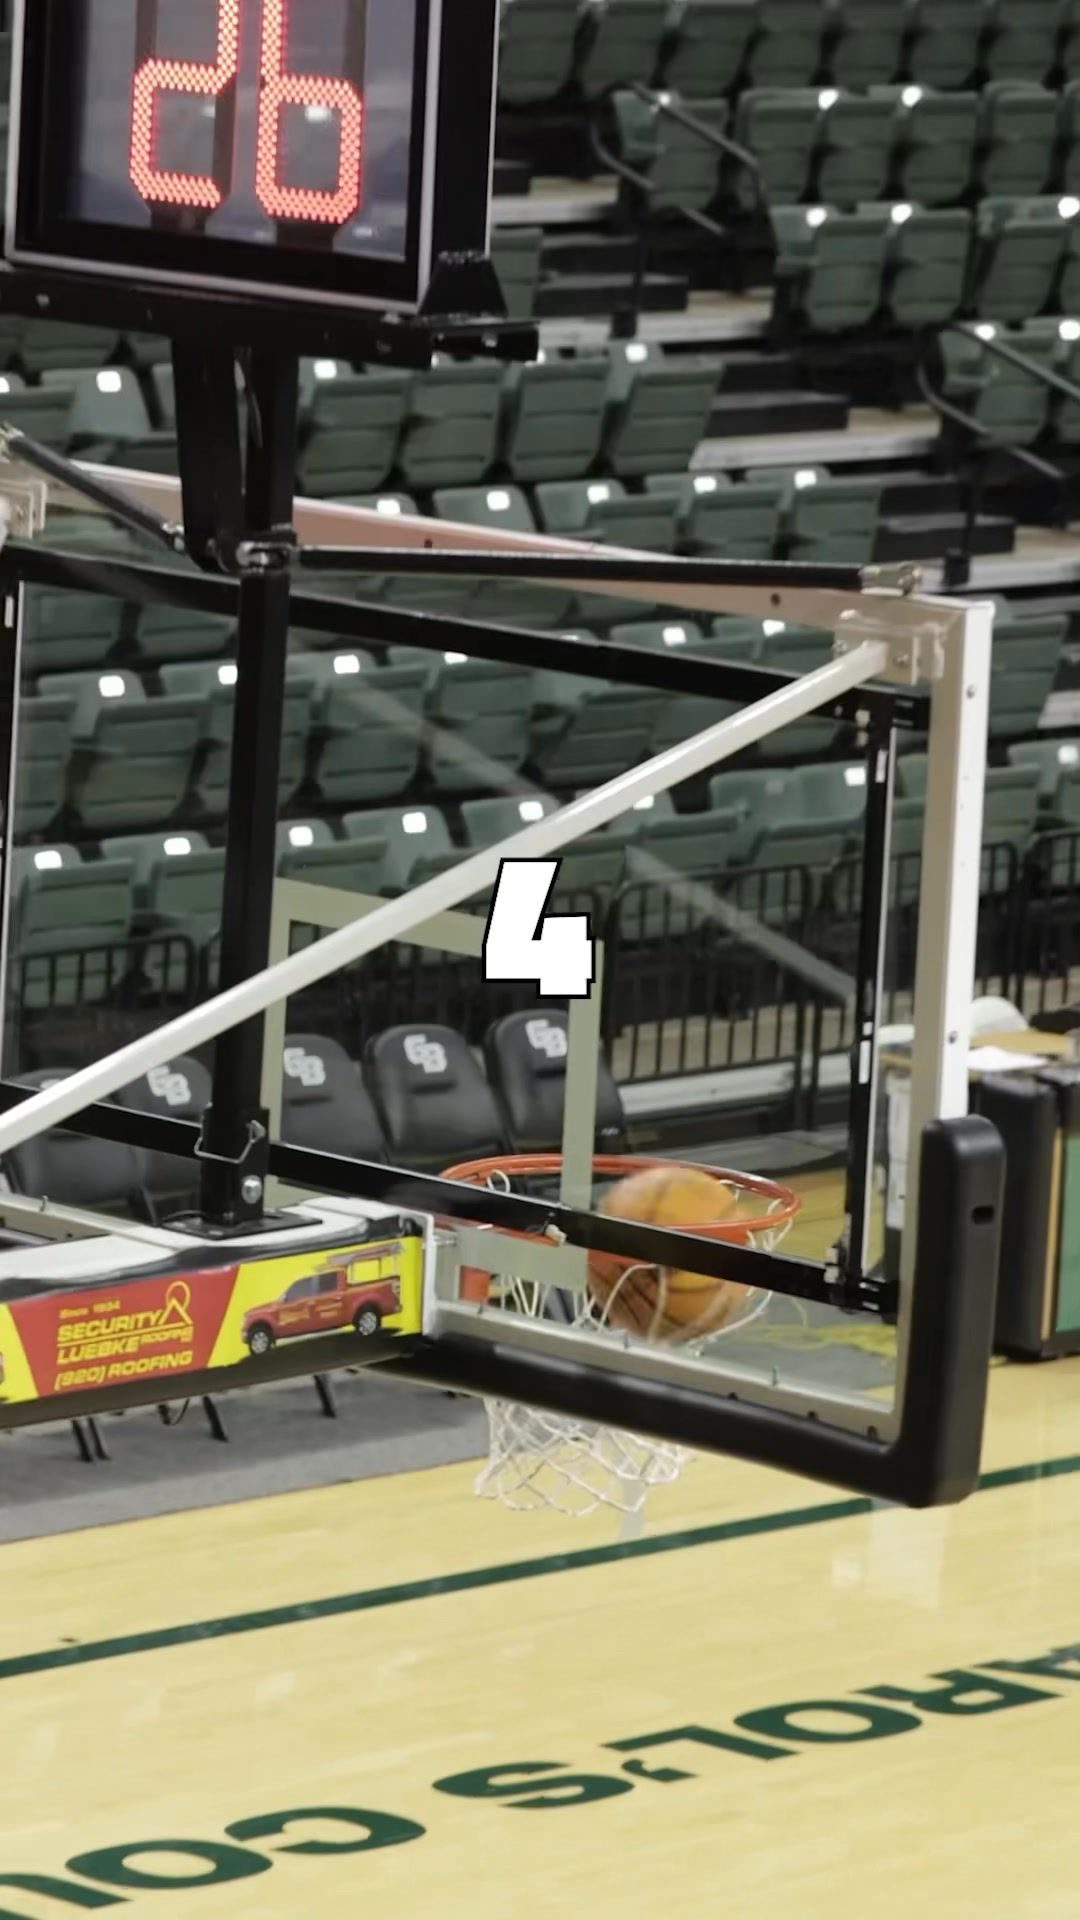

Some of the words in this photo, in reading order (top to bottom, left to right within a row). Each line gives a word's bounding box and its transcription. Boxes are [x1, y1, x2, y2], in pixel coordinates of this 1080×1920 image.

[130, 0, 362, 223] 26
[57, 1309, 163, 1342] SECURITY
[57, 1336, 140, 1365] LUEBKE
[54, 1365, 106, 1391] (920)
[108, 1350, 193, 1378] ROOFING
